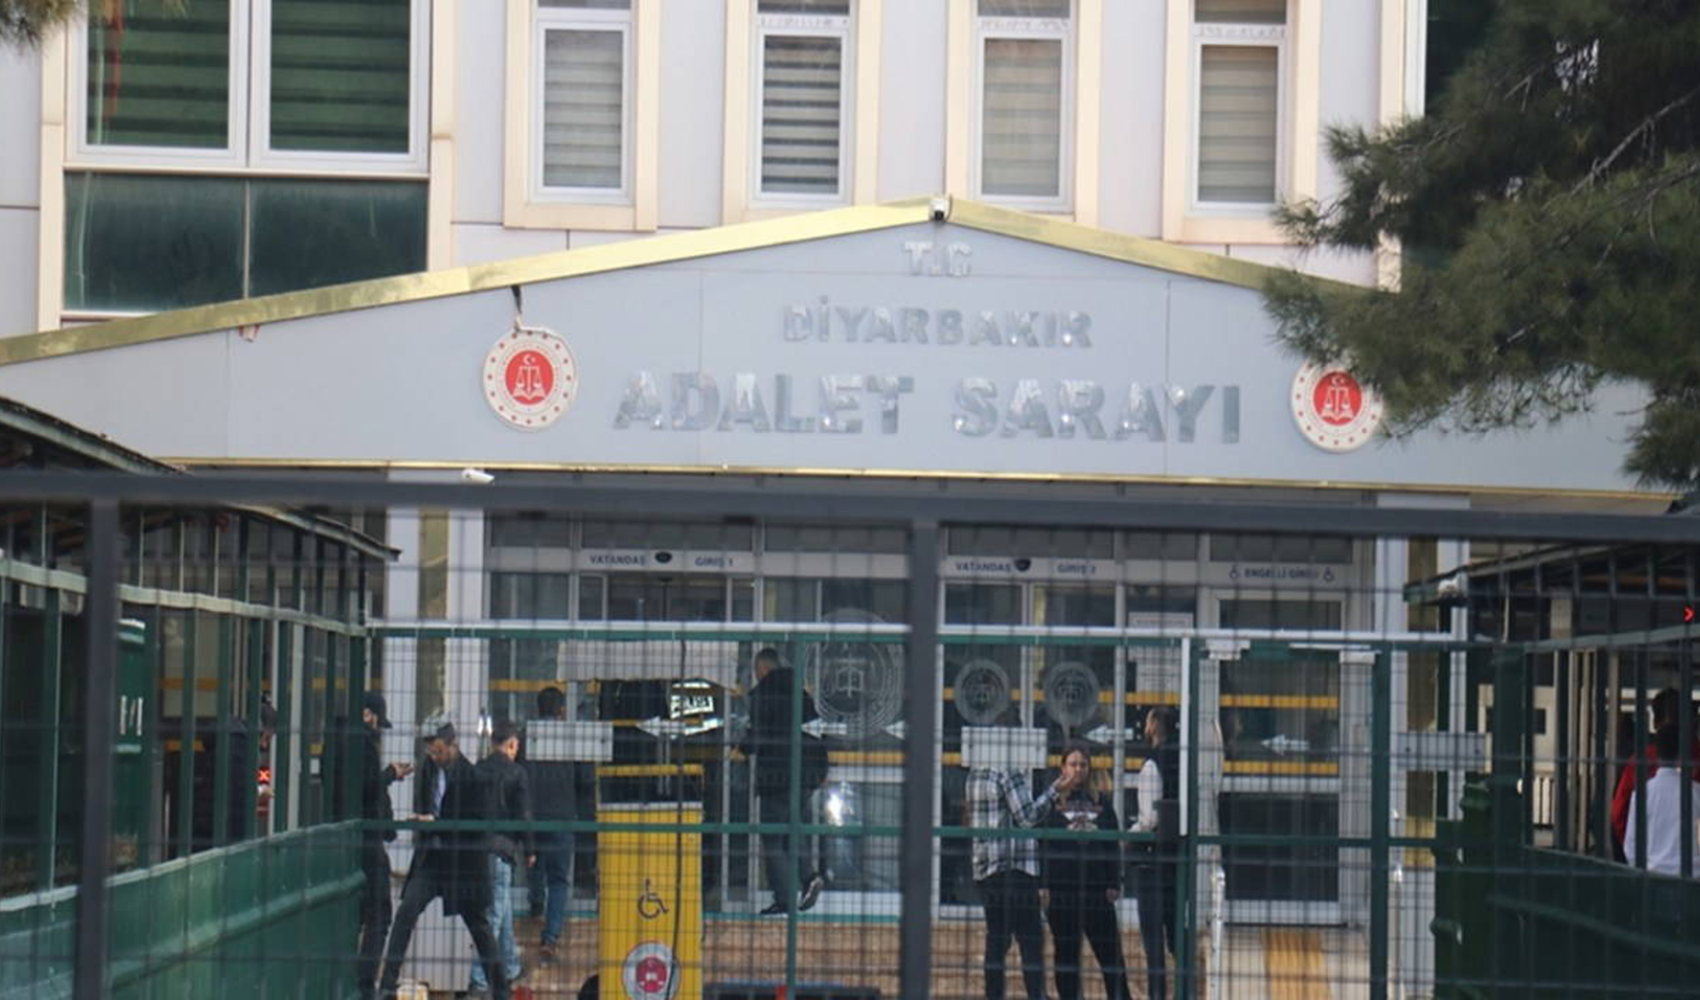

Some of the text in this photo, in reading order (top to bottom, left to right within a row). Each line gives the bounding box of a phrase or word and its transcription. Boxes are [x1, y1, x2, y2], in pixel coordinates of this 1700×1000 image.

[782, 294, 1093, 348] DİYARBAKIR
[612, 370, 915, 434] ADALET
[950, 376, 1240, 445] SARAYI
